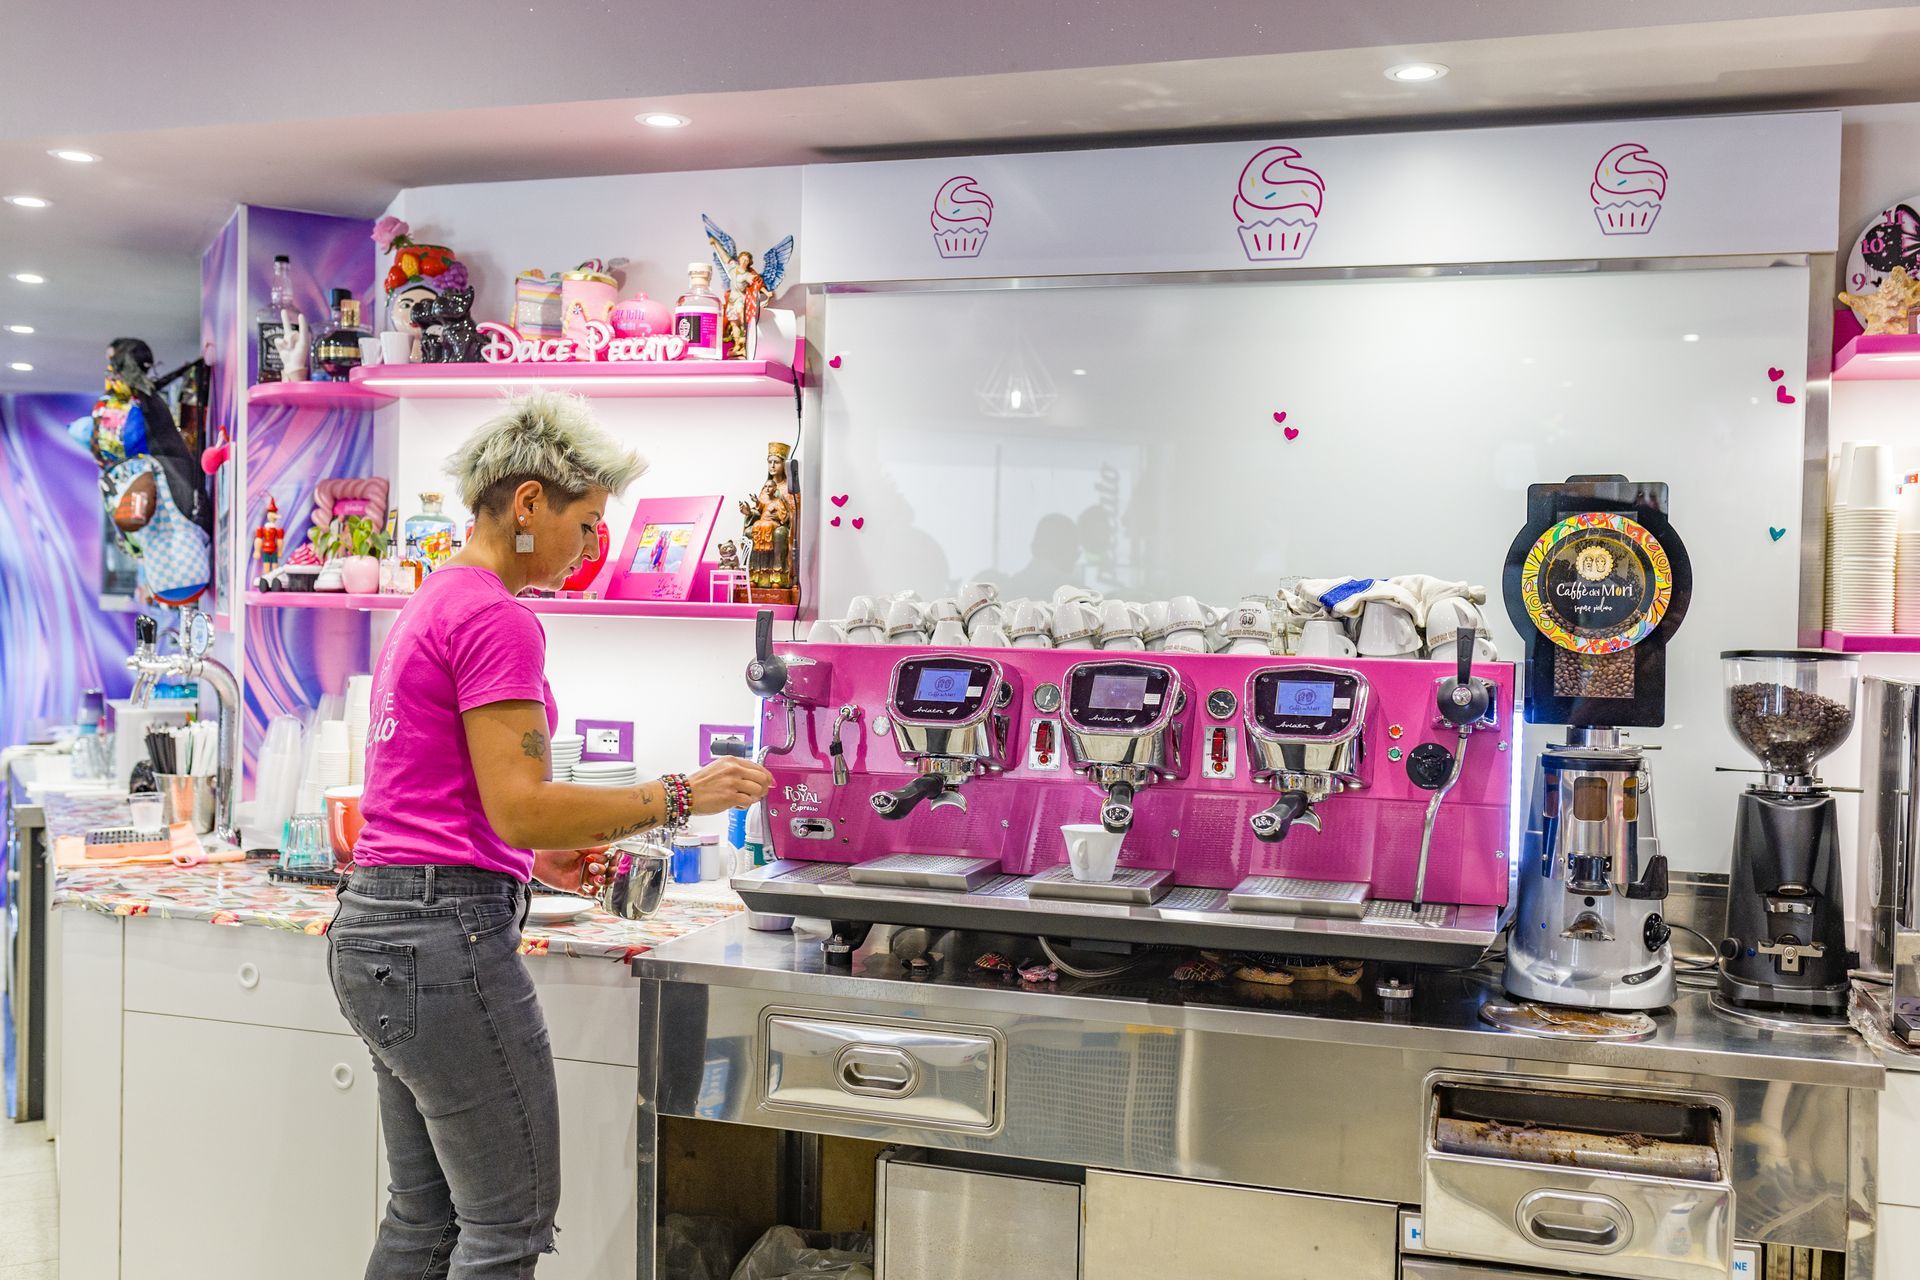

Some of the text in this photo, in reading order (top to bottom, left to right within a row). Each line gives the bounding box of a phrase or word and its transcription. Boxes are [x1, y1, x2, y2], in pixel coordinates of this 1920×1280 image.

[1884, 210, 1905, 226] 11
[1861, 237, 1885, 254] 10
[1852, 273, 1867, 291] 9
[1556, 582, 1588, 600] Caffè
[1601, 584, 1633, 597] Mori
[913, 706, 944, 714] Aviator
[1276, 721, 1311, 729] Aviator
